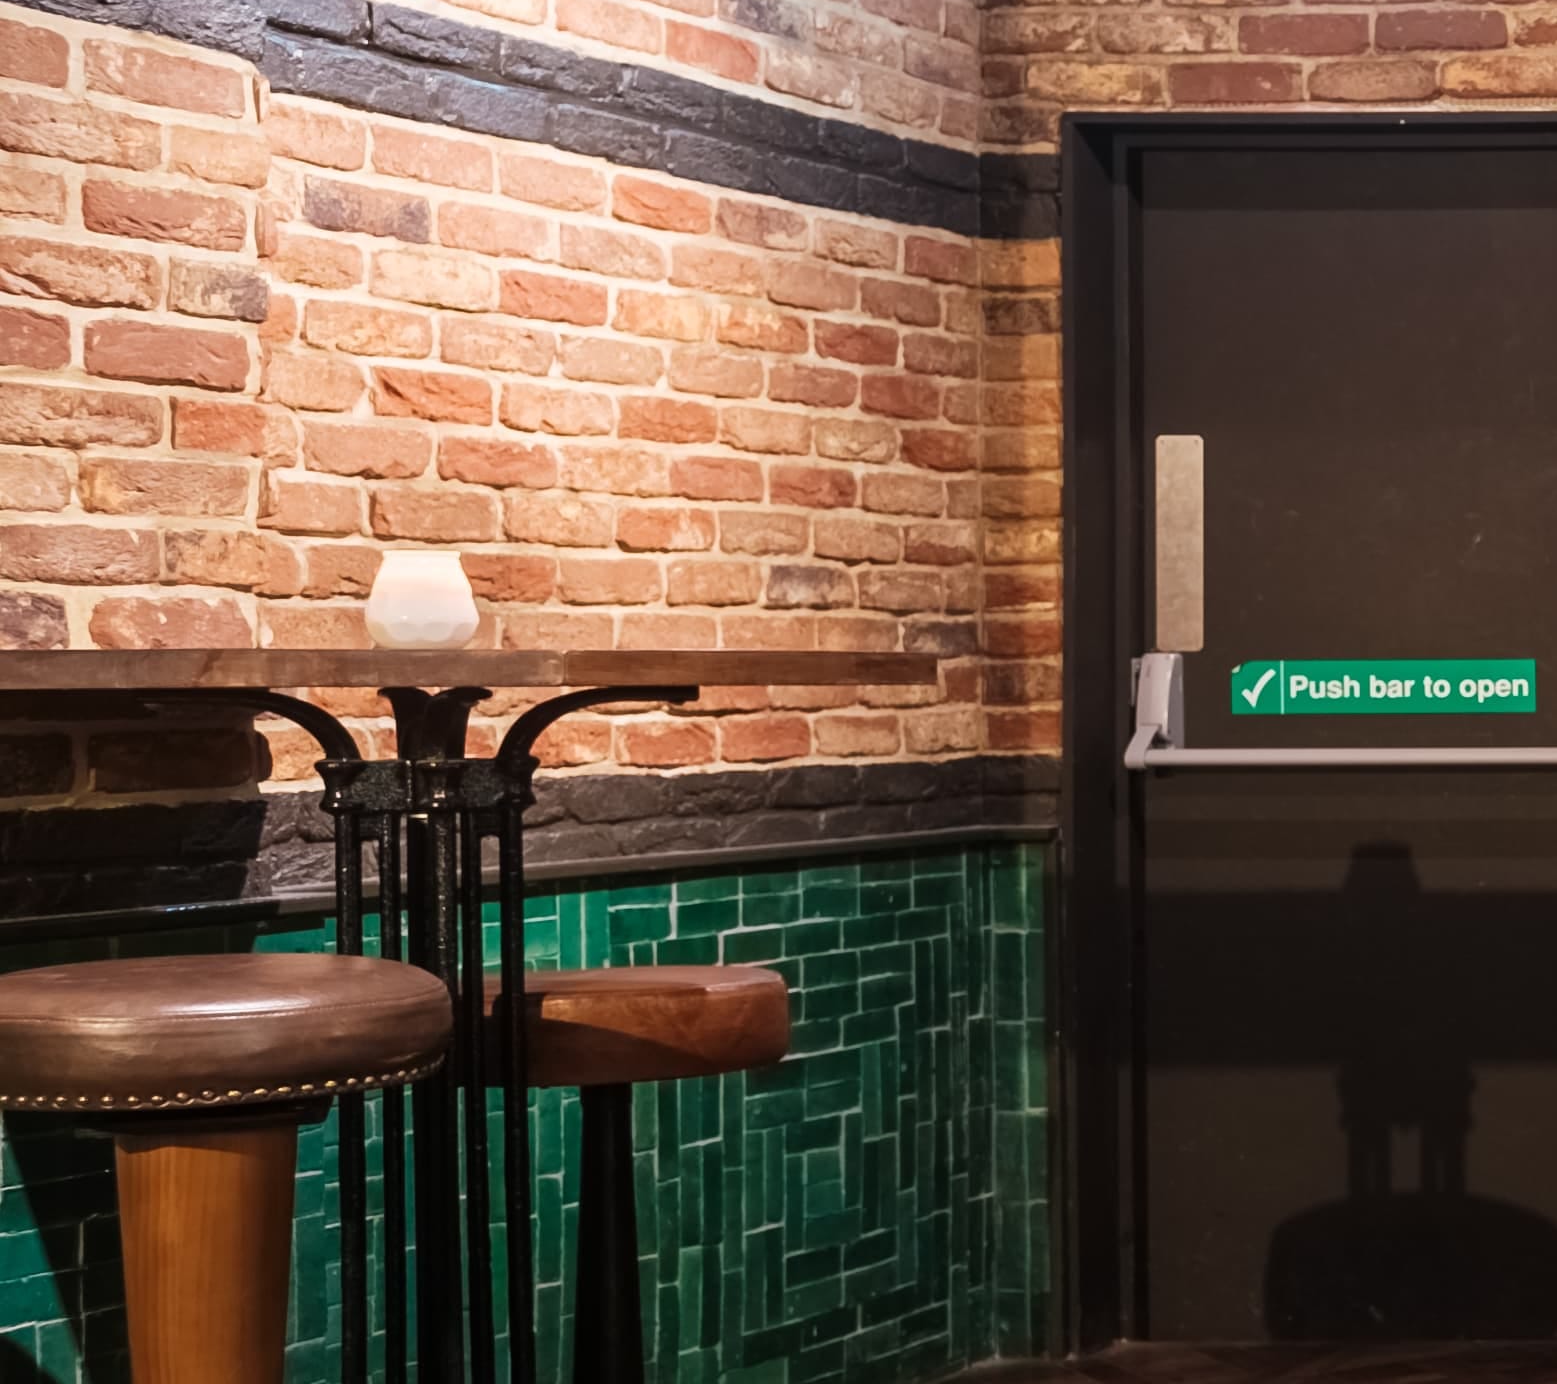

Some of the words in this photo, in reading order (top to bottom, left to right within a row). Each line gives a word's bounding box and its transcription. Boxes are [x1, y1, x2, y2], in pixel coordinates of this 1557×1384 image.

[1289, 675, 1360, 699] Push
[1369, 675, 1415, 699] bar
[1423, 675, 1451, 699] to
[1459, 678, 1529, 703] open
